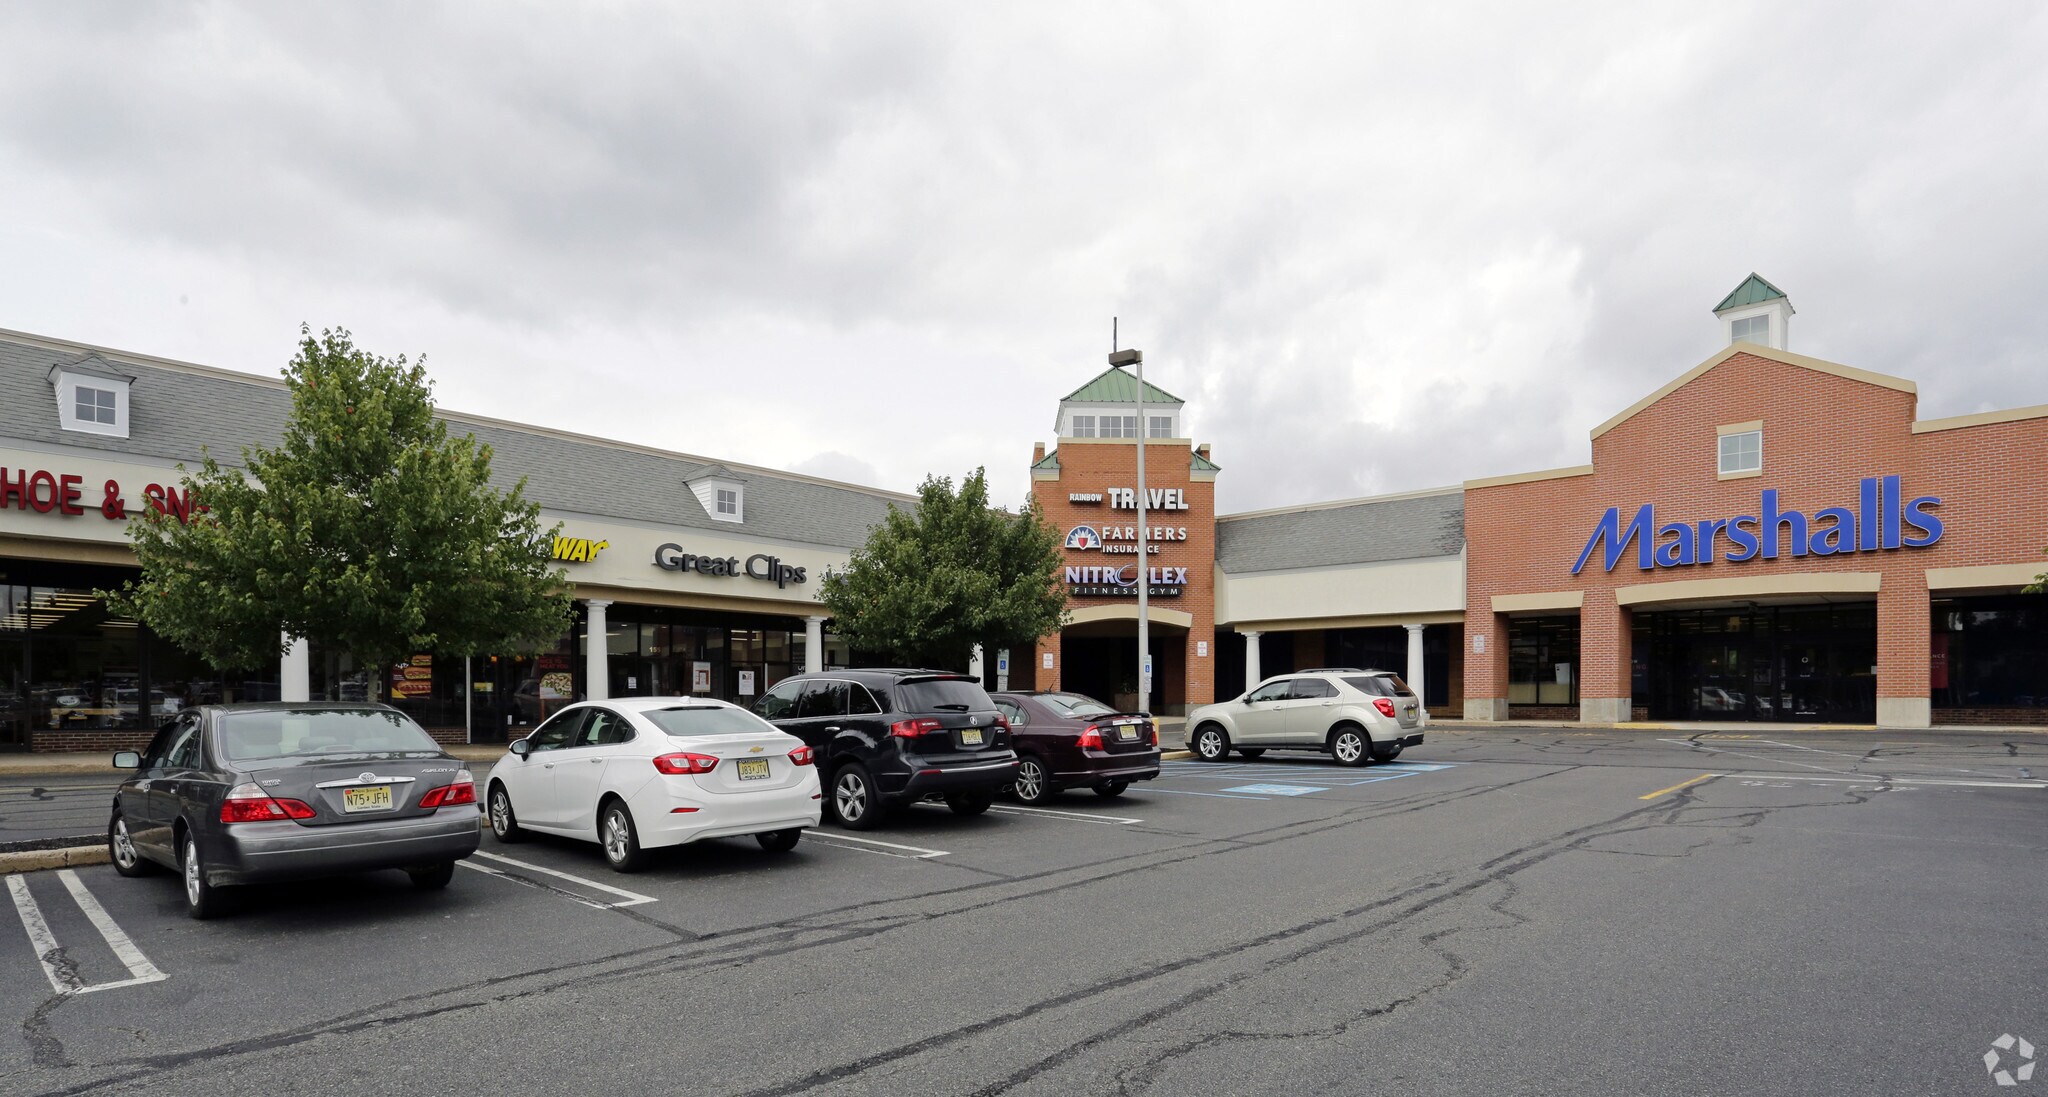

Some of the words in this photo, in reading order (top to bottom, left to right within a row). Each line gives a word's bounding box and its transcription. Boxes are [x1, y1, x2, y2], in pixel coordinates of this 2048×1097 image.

[102, 479, 127, 520] &
[1069, 493, 1103, 503] RAINBOW
[1570, 474, 1944, 575] Marshalls
[1102, 544, 1160, 554] INSURACE
[654, 543, 740, 577] Great
[745, 554, 807, 590] Clips
[1065, 563, 1188, 587] NITROLEX
[1074, 587, 1138, 595] FITNESS
[1149, 587, 1179, 595] GYM
[347, 794, 365, 806] N75
[372, 792, 389, 804] JFH
